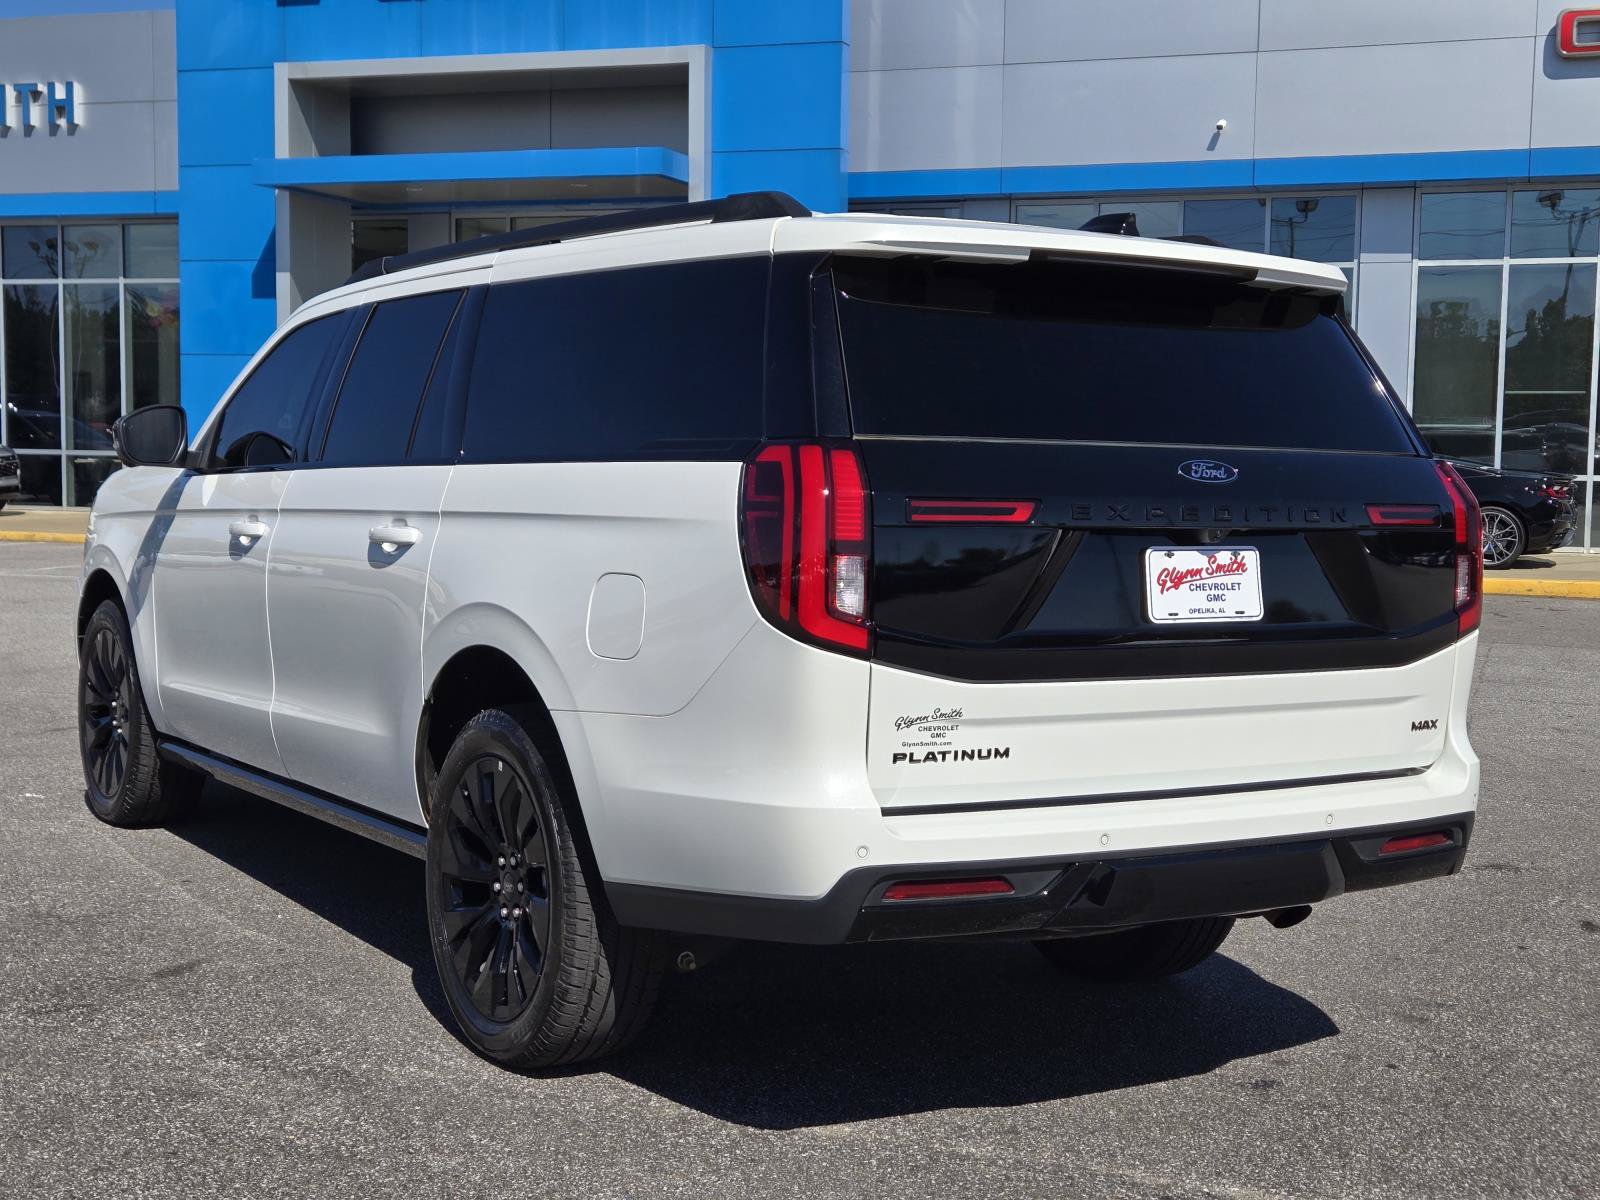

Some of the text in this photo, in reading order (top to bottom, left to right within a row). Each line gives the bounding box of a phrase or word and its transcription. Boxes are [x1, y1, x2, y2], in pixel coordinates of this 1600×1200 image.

[1190, 462, 1228, 480] Ford
[1069, 502, 1349, 523] EXPEDITION
[1157, 554, 1248, 595] Glynn Smith
[1188, 582, 1242, 592] CHEVROLET
[1206, 593, 1227, 602] GMC
[1188, 607, 1218, 615] OPELIKA,
[894, 706, 964, 732] Glynn Smith
[1410, 718, 1440, 732] MAX
[917, 724, 960, 732] CHEVROLET
[892, 747, 1011, 765] PLATINUM
